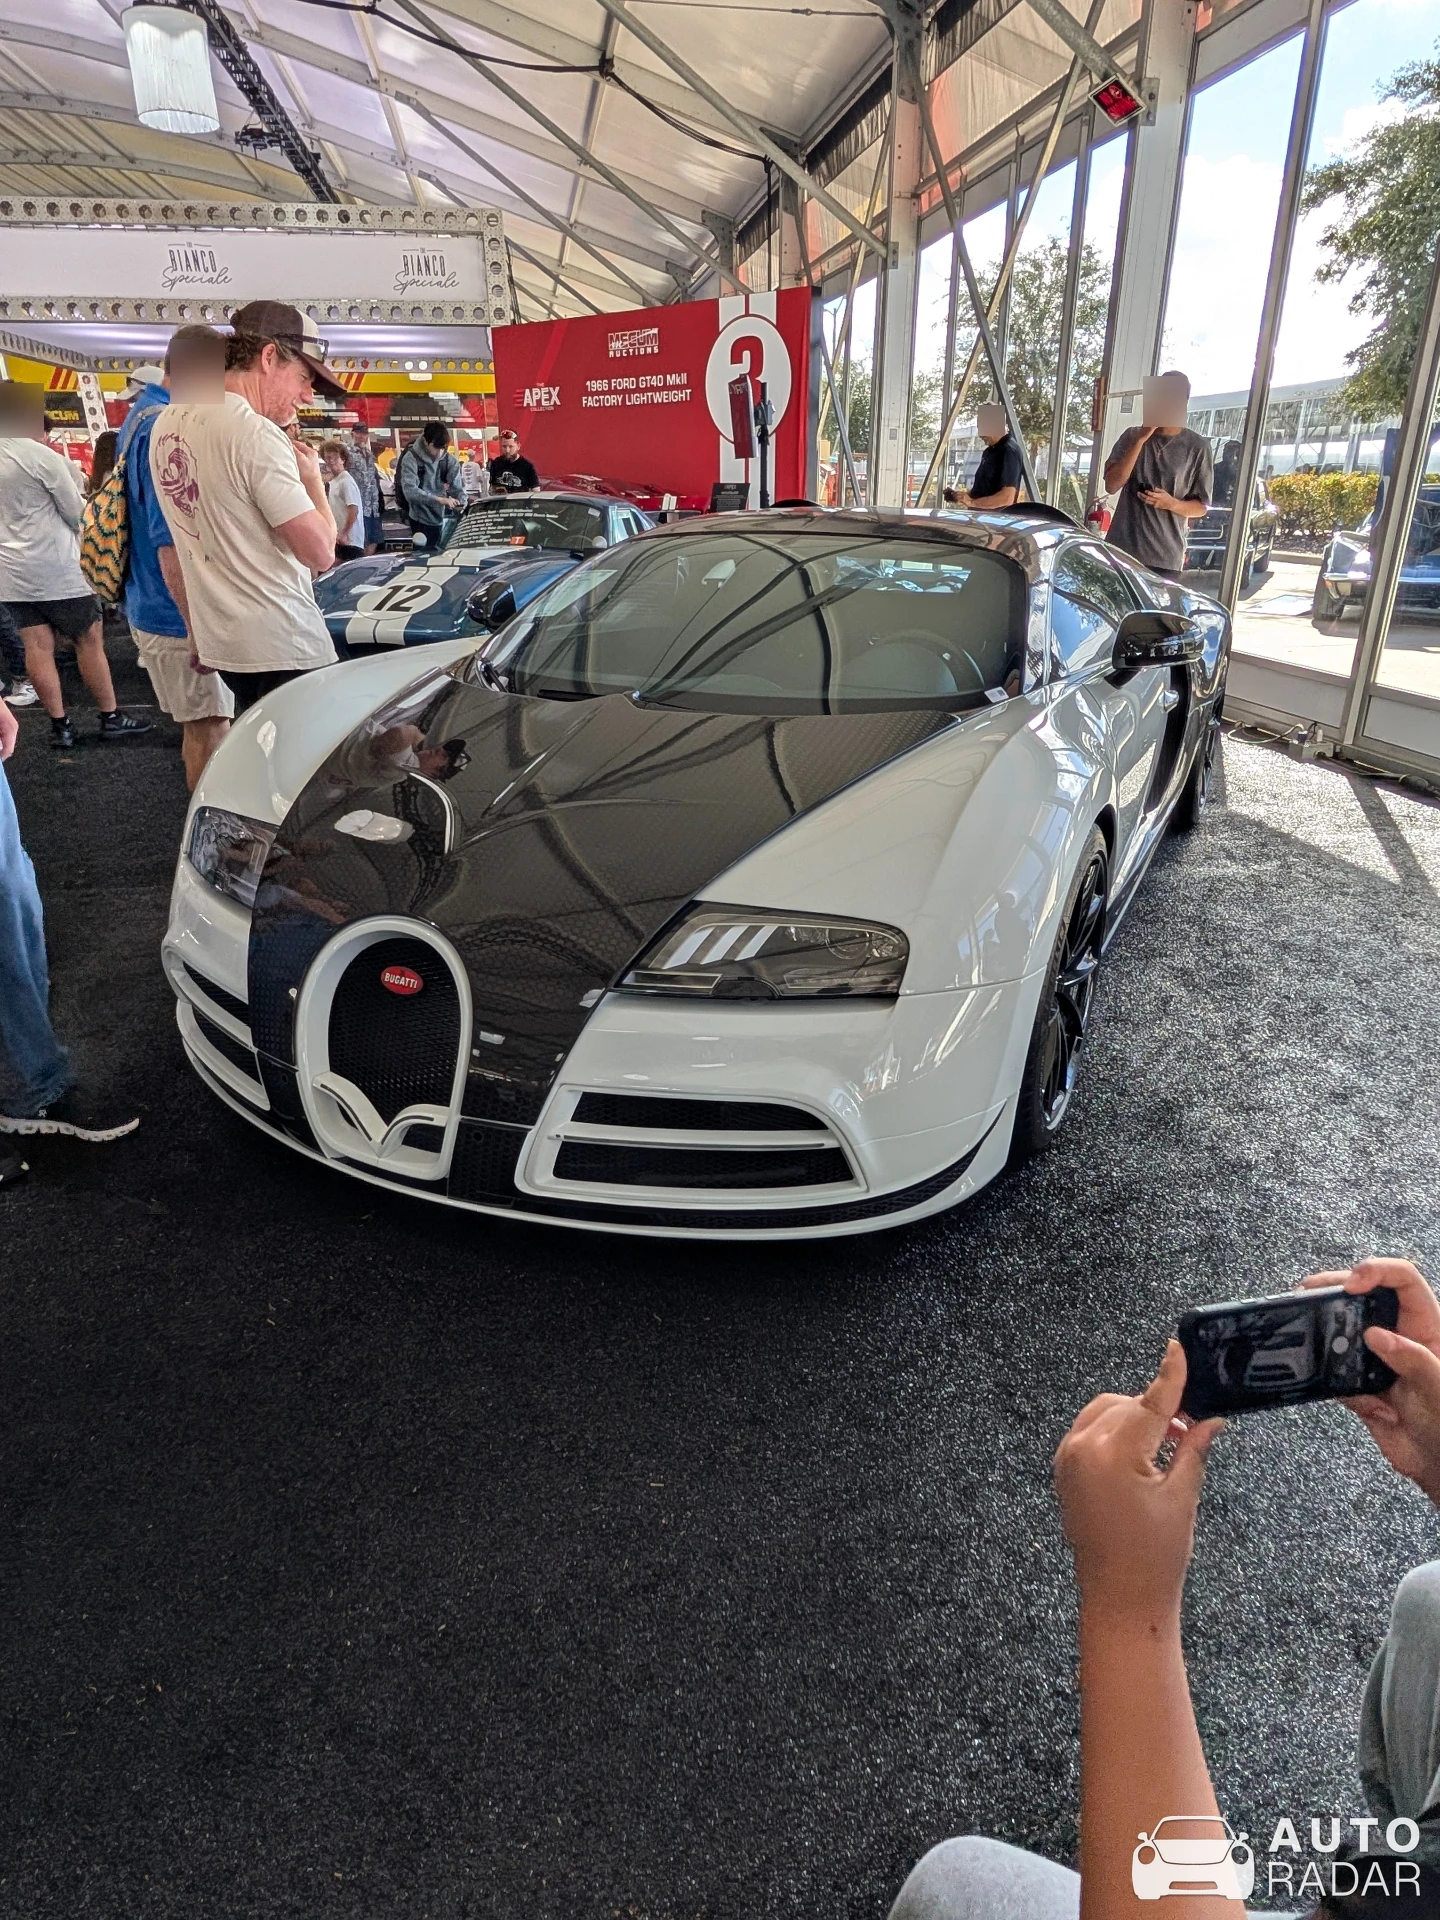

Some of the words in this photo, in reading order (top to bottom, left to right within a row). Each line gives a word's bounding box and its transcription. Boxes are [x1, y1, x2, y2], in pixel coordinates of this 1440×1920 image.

[168, 249, 217, 273] BIANCO
[402, 254, 446, 277] BIANCO
[161, 266, 232, 292] Speciale
[393, 270, 460, 295] Speciale
[608, 328, 659, 350] MECUM
[608, 345, 659, 358] AUCTIONS
[585, 379, 609, 392] 1966
[611, 377, 637, 390] FORD
[638, 374, 664, 389] GT40
[523, 386, 561, 407] APEX
[582, 394, 623, 408] FACTORY
[625, 389, 692, 406] LIGHTWEIGHT
[372, 584, 431, 612] 12
[384, 972, 418, 989] BUGATTI
